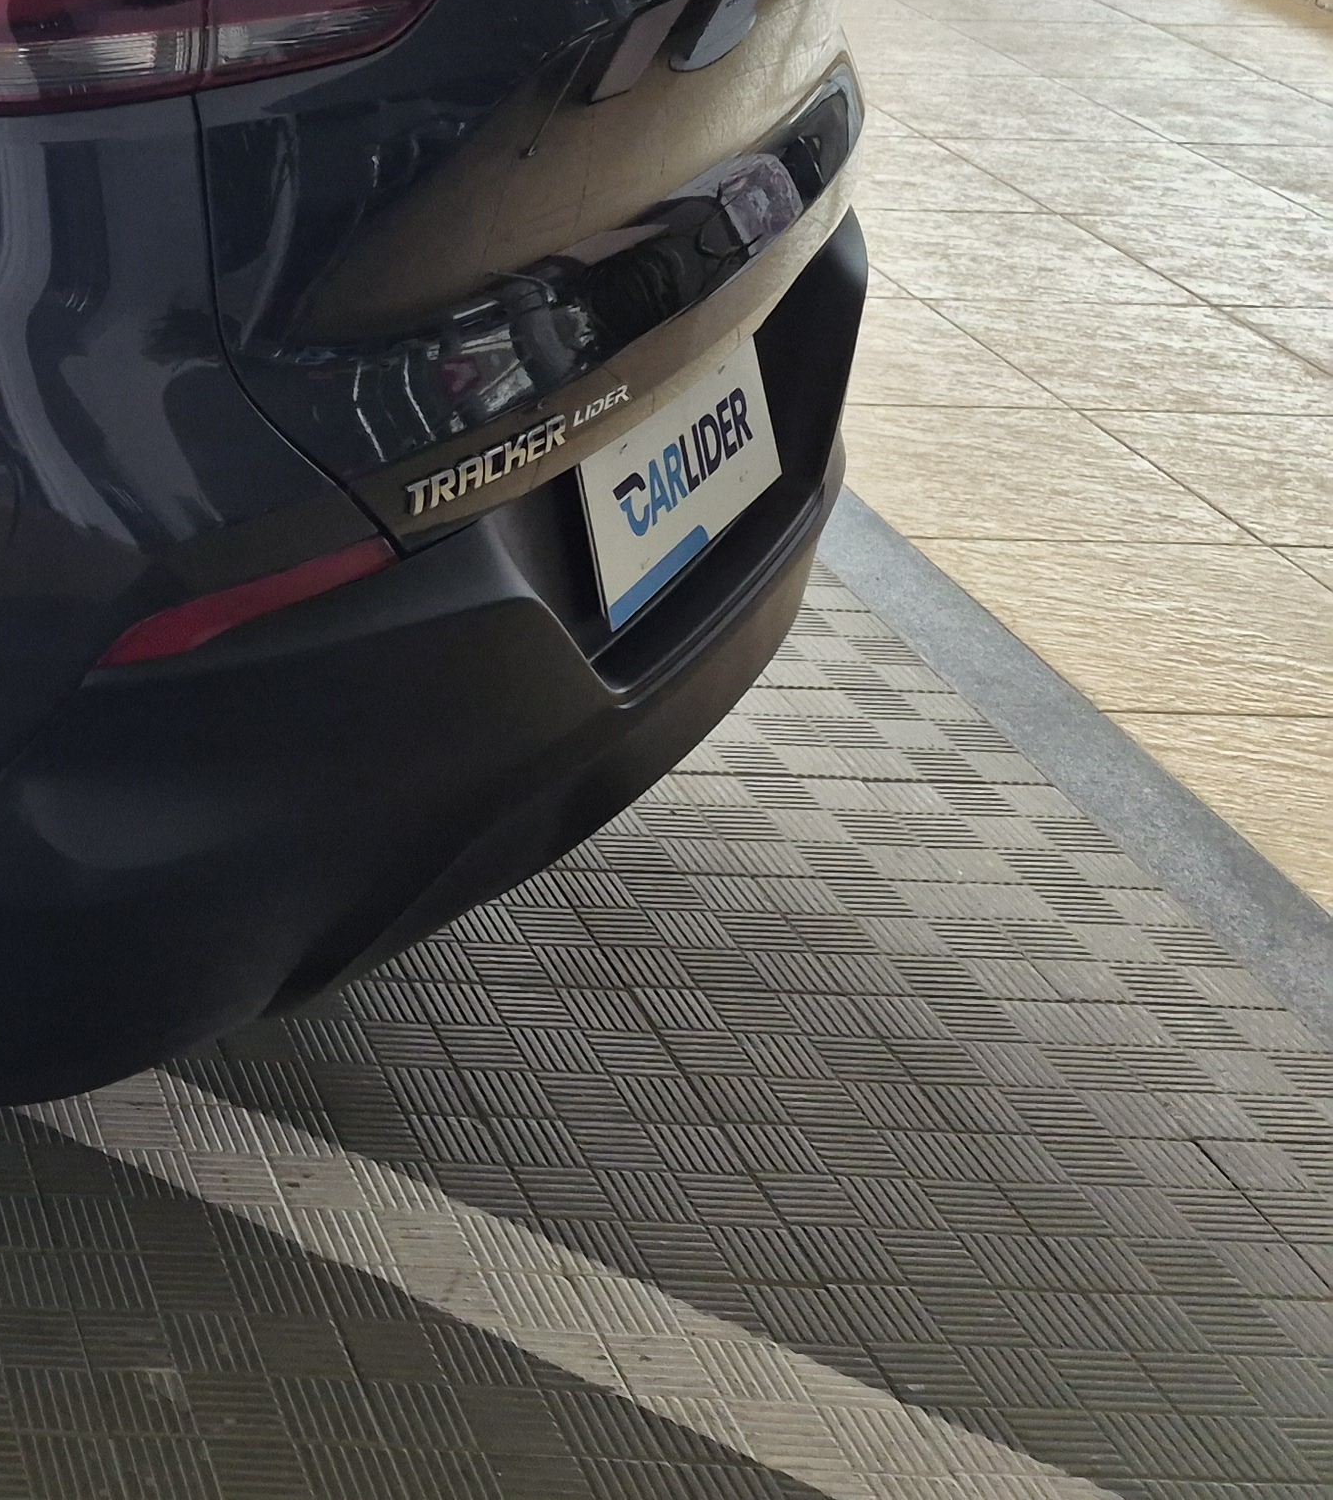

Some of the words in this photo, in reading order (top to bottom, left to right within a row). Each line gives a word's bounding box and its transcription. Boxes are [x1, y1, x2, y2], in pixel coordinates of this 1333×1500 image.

[405, 413, 567, 517] TRACKER
[572, 384, 630, 428] LIDER
[612, 387, 754, 537] CARLIDER
